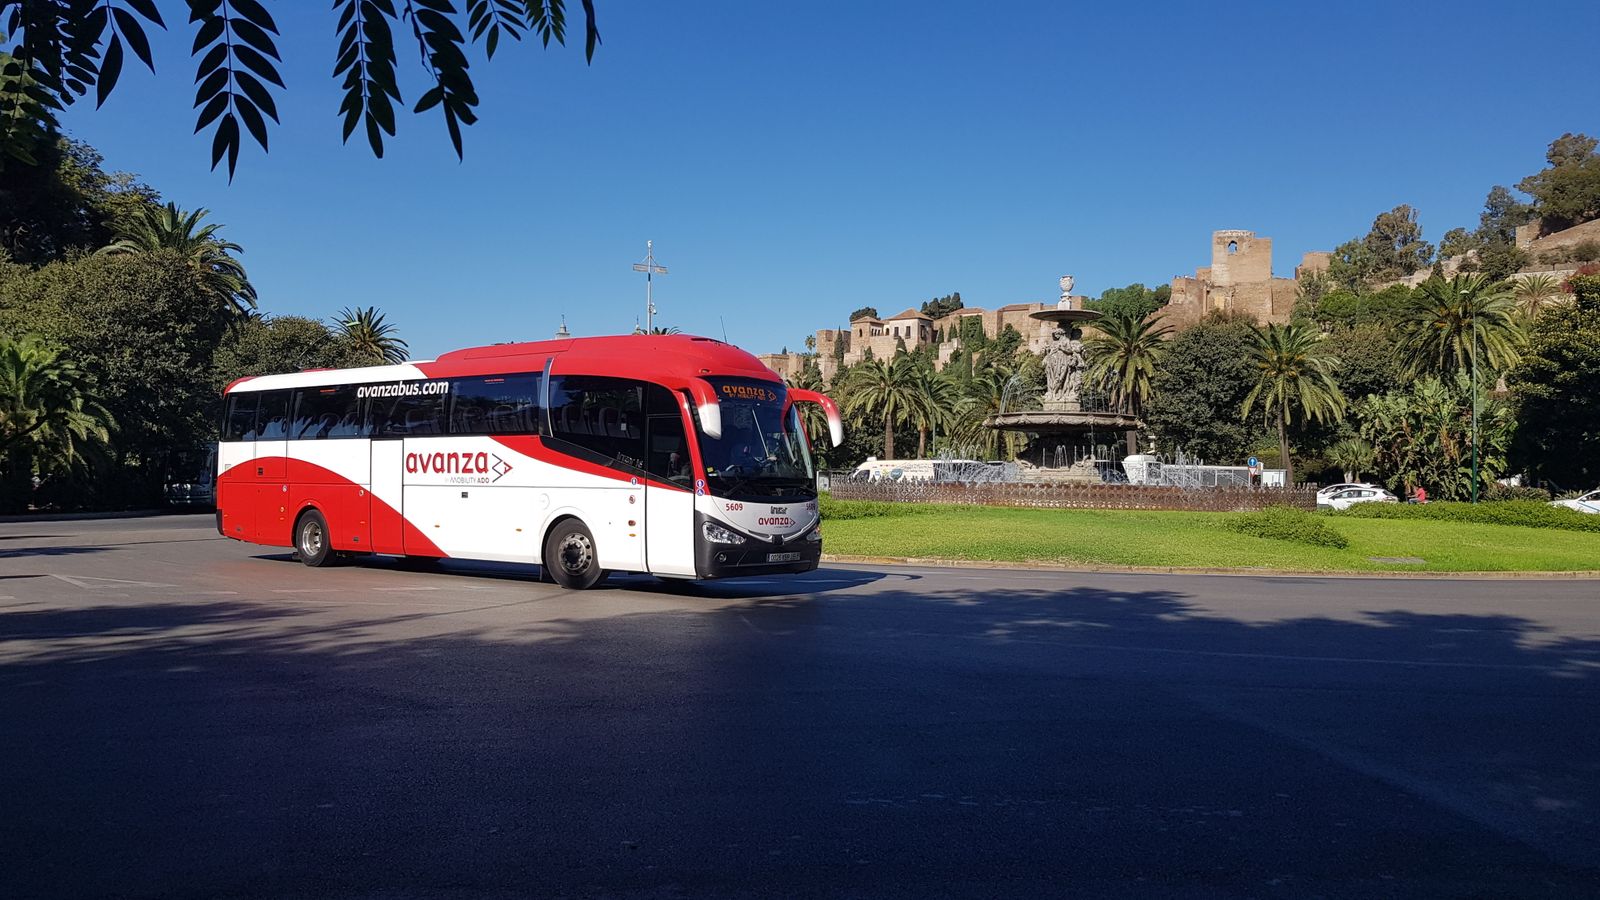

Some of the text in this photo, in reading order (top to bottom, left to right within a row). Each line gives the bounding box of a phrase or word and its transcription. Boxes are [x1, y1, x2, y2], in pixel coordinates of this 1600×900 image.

[357, 381, 449, 398] avanzabus.com
[722, 385, 766, 397] avanza
[406, 451, 489, 474] avanza
[725, 503, 743, 512] 5609
[758, 517, 789, 526] avanza
